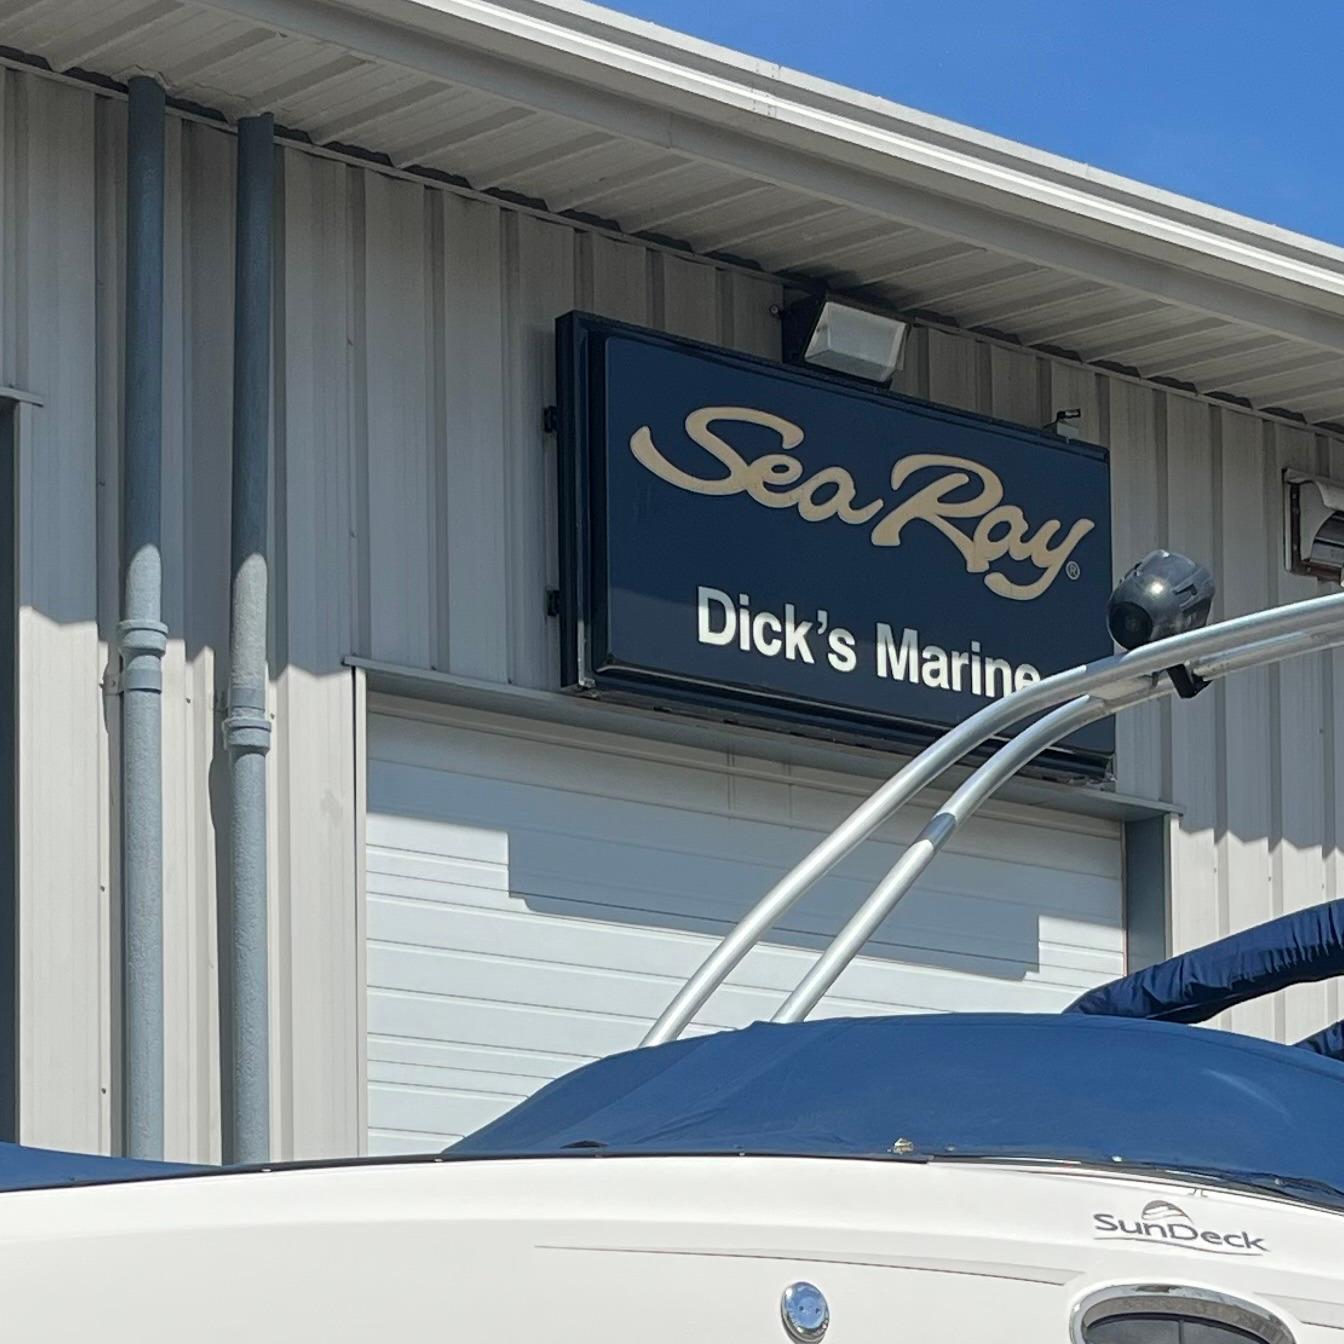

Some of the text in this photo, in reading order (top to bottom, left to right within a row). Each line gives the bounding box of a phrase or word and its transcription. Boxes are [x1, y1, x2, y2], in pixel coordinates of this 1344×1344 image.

[630, 407, 1095, 600] Sea Ray
[696, 585, 1041, 698] Dick's Marine
[1093, 1213, 1270, 1252] SunDeck
